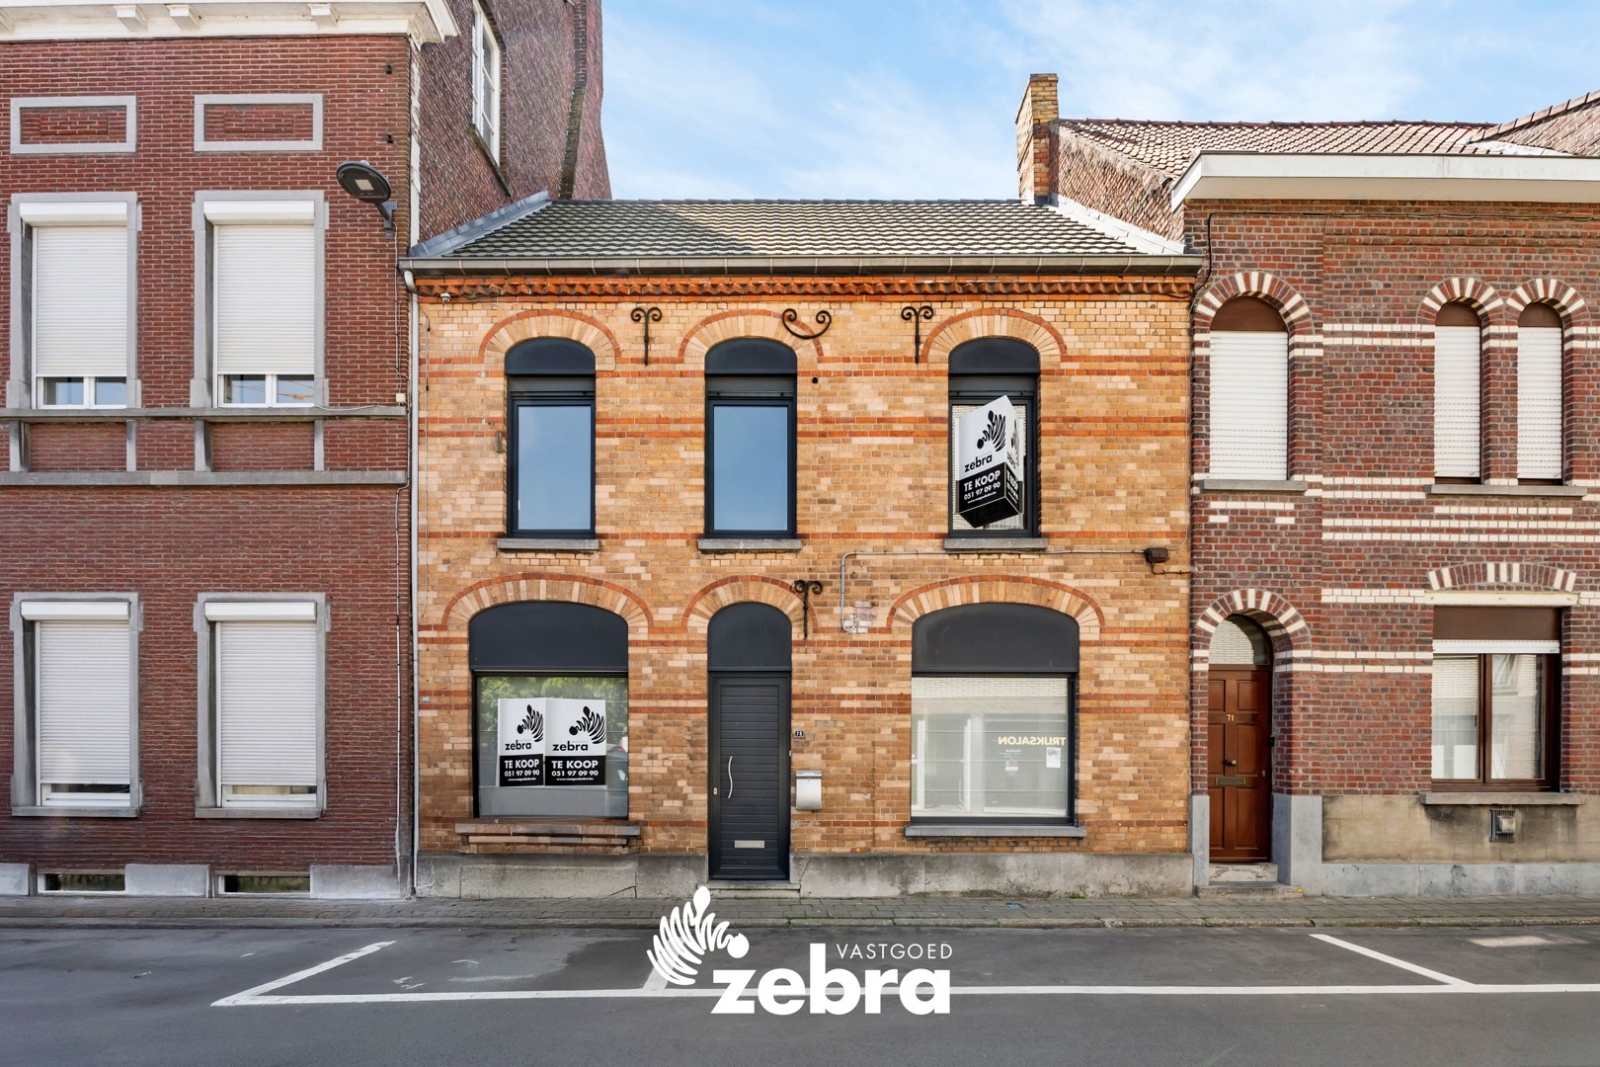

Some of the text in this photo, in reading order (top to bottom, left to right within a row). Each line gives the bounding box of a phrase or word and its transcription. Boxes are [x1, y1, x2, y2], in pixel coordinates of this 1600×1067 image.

[964, 454, 992, 472] zebra
[964, 481, 972, 492] TE
[974, 470, 1000, 488] KOOP
[964, 492, 974, 500] 051
[505, 740, 532, 750] zebra
[552, 741, 588, 751] zebra
[504, 759, 539, 769] TE KOOP
[551, 760, 598, 769] TE KOOP
